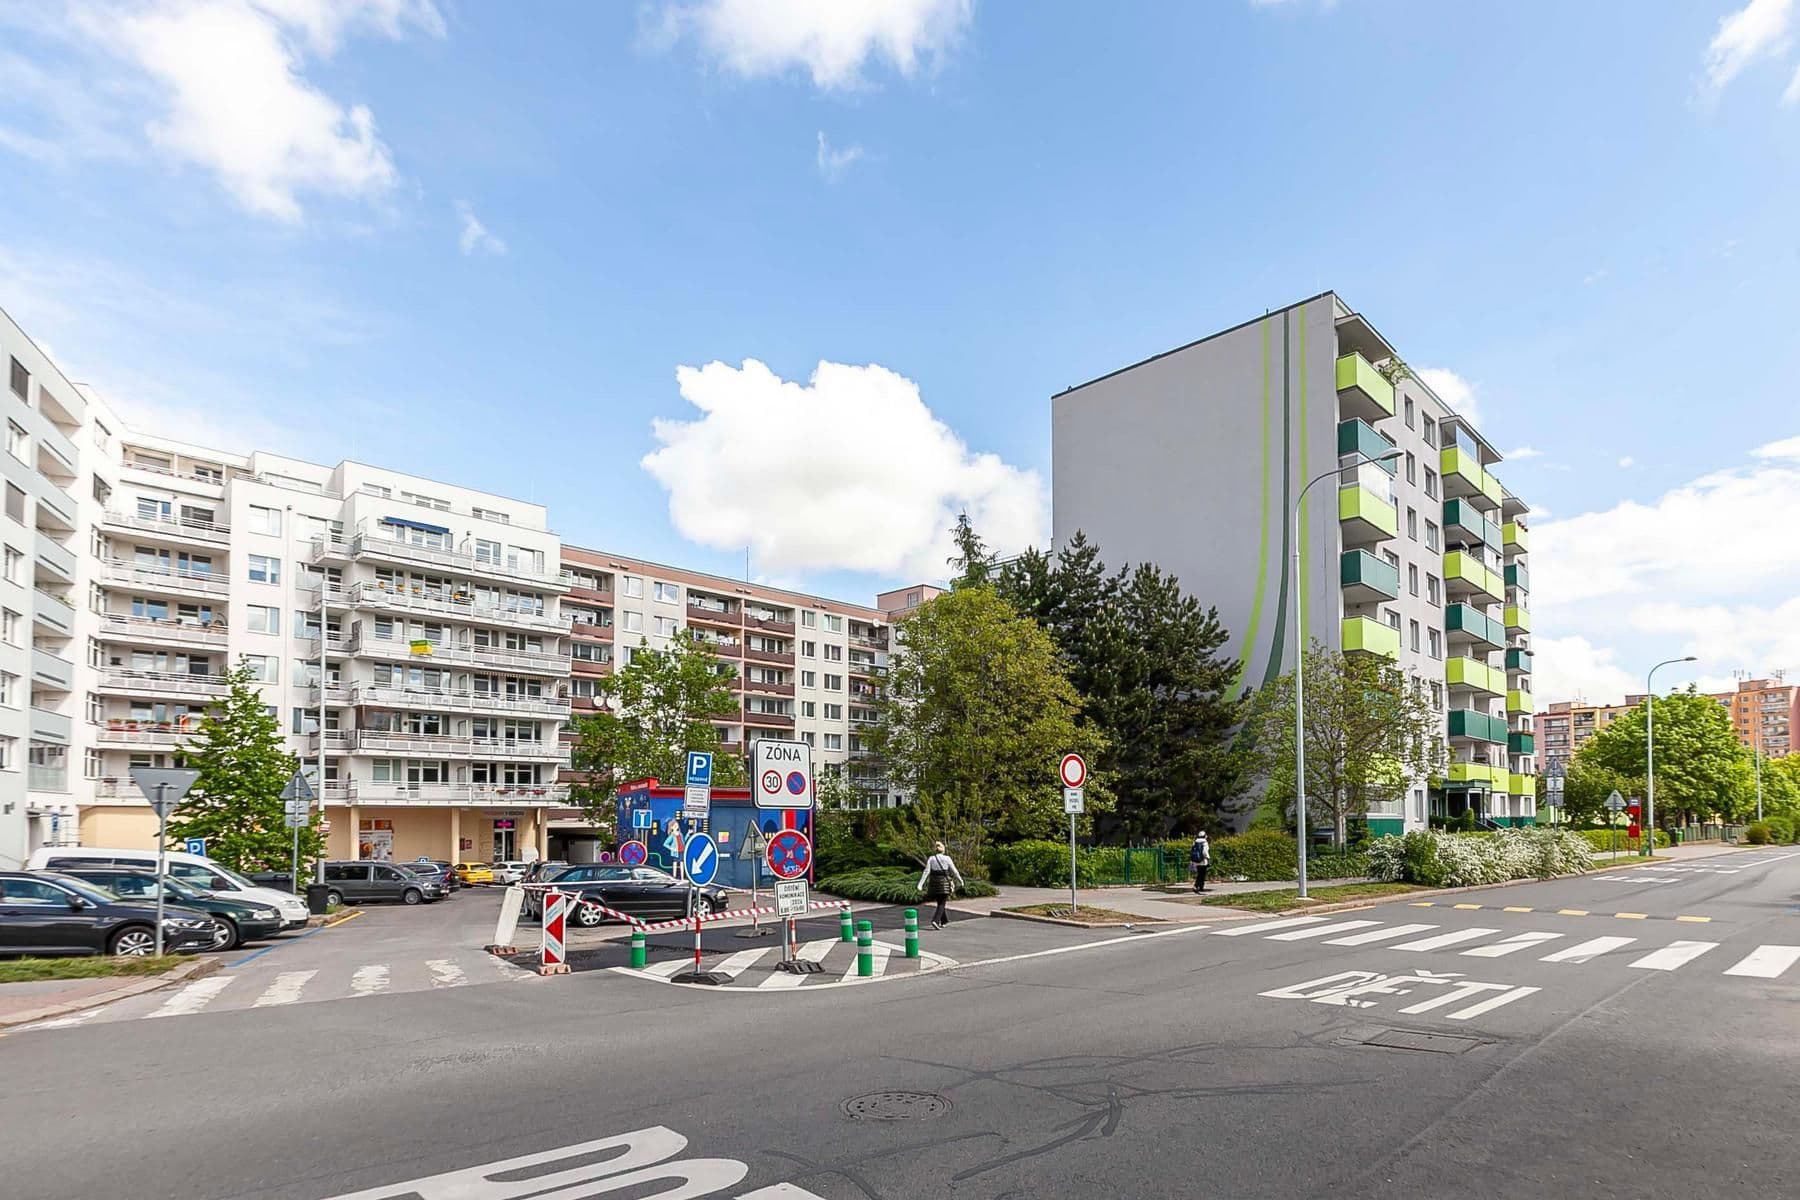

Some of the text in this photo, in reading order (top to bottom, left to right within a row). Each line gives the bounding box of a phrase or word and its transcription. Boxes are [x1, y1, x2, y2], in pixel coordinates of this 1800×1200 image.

[766, 744, 802, 762] ZÓNA
[692, 757, 707, 775] P
[765, 776, 778, 789] 30
[190, 842, 201, 853] P
[1257, 969, 1543, 1020] DĚTI
